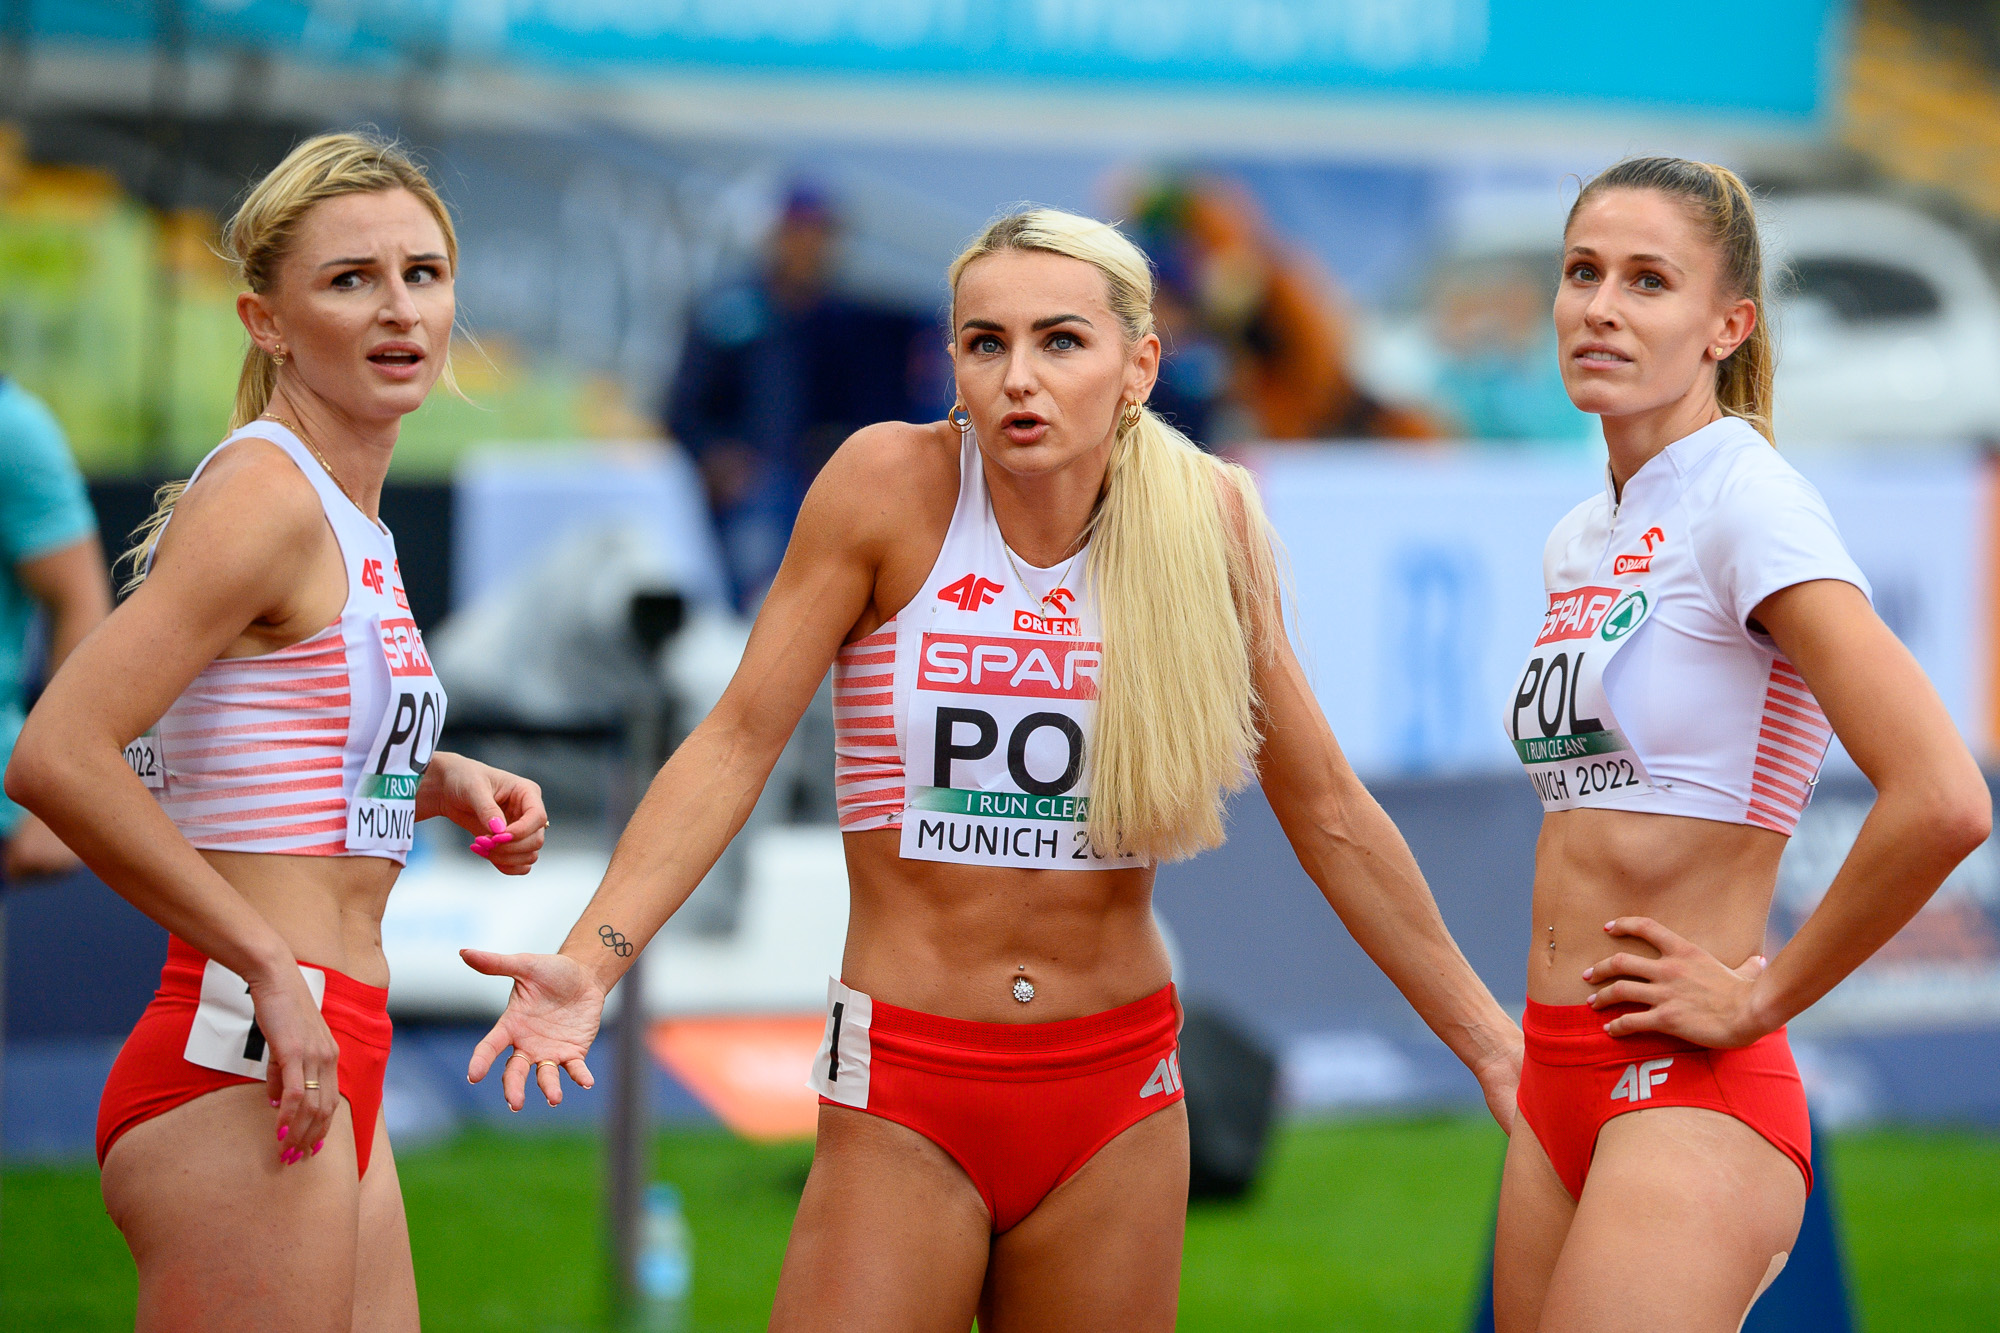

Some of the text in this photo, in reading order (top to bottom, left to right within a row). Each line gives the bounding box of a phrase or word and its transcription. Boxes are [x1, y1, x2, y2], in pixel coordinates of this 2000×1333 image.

[361, 558, 385, 595] 4F
[937, 573, 1004, 612] 4F
[1017, 614, 1077, 636] ORLEN
[1540, 593, 1613, 639] SPAR
[924, 642, 1101, 690] SPAR
[1512, 651, 1605, 741] POL
[1525, 742, 1531, 760] I
[1530, 740, 1547, 760] RUN
[384, 778, 390, 796] I
[1576, 758, 1639, 796] 2022
[966, 796, 973, 812] I
[979, 796, 1028, 815] RUN
[918, 819, 1059, 859] MUNICH
[828, 1001, 845, 1082] 1
[1610, 1056, 1674, 1102] 4F
